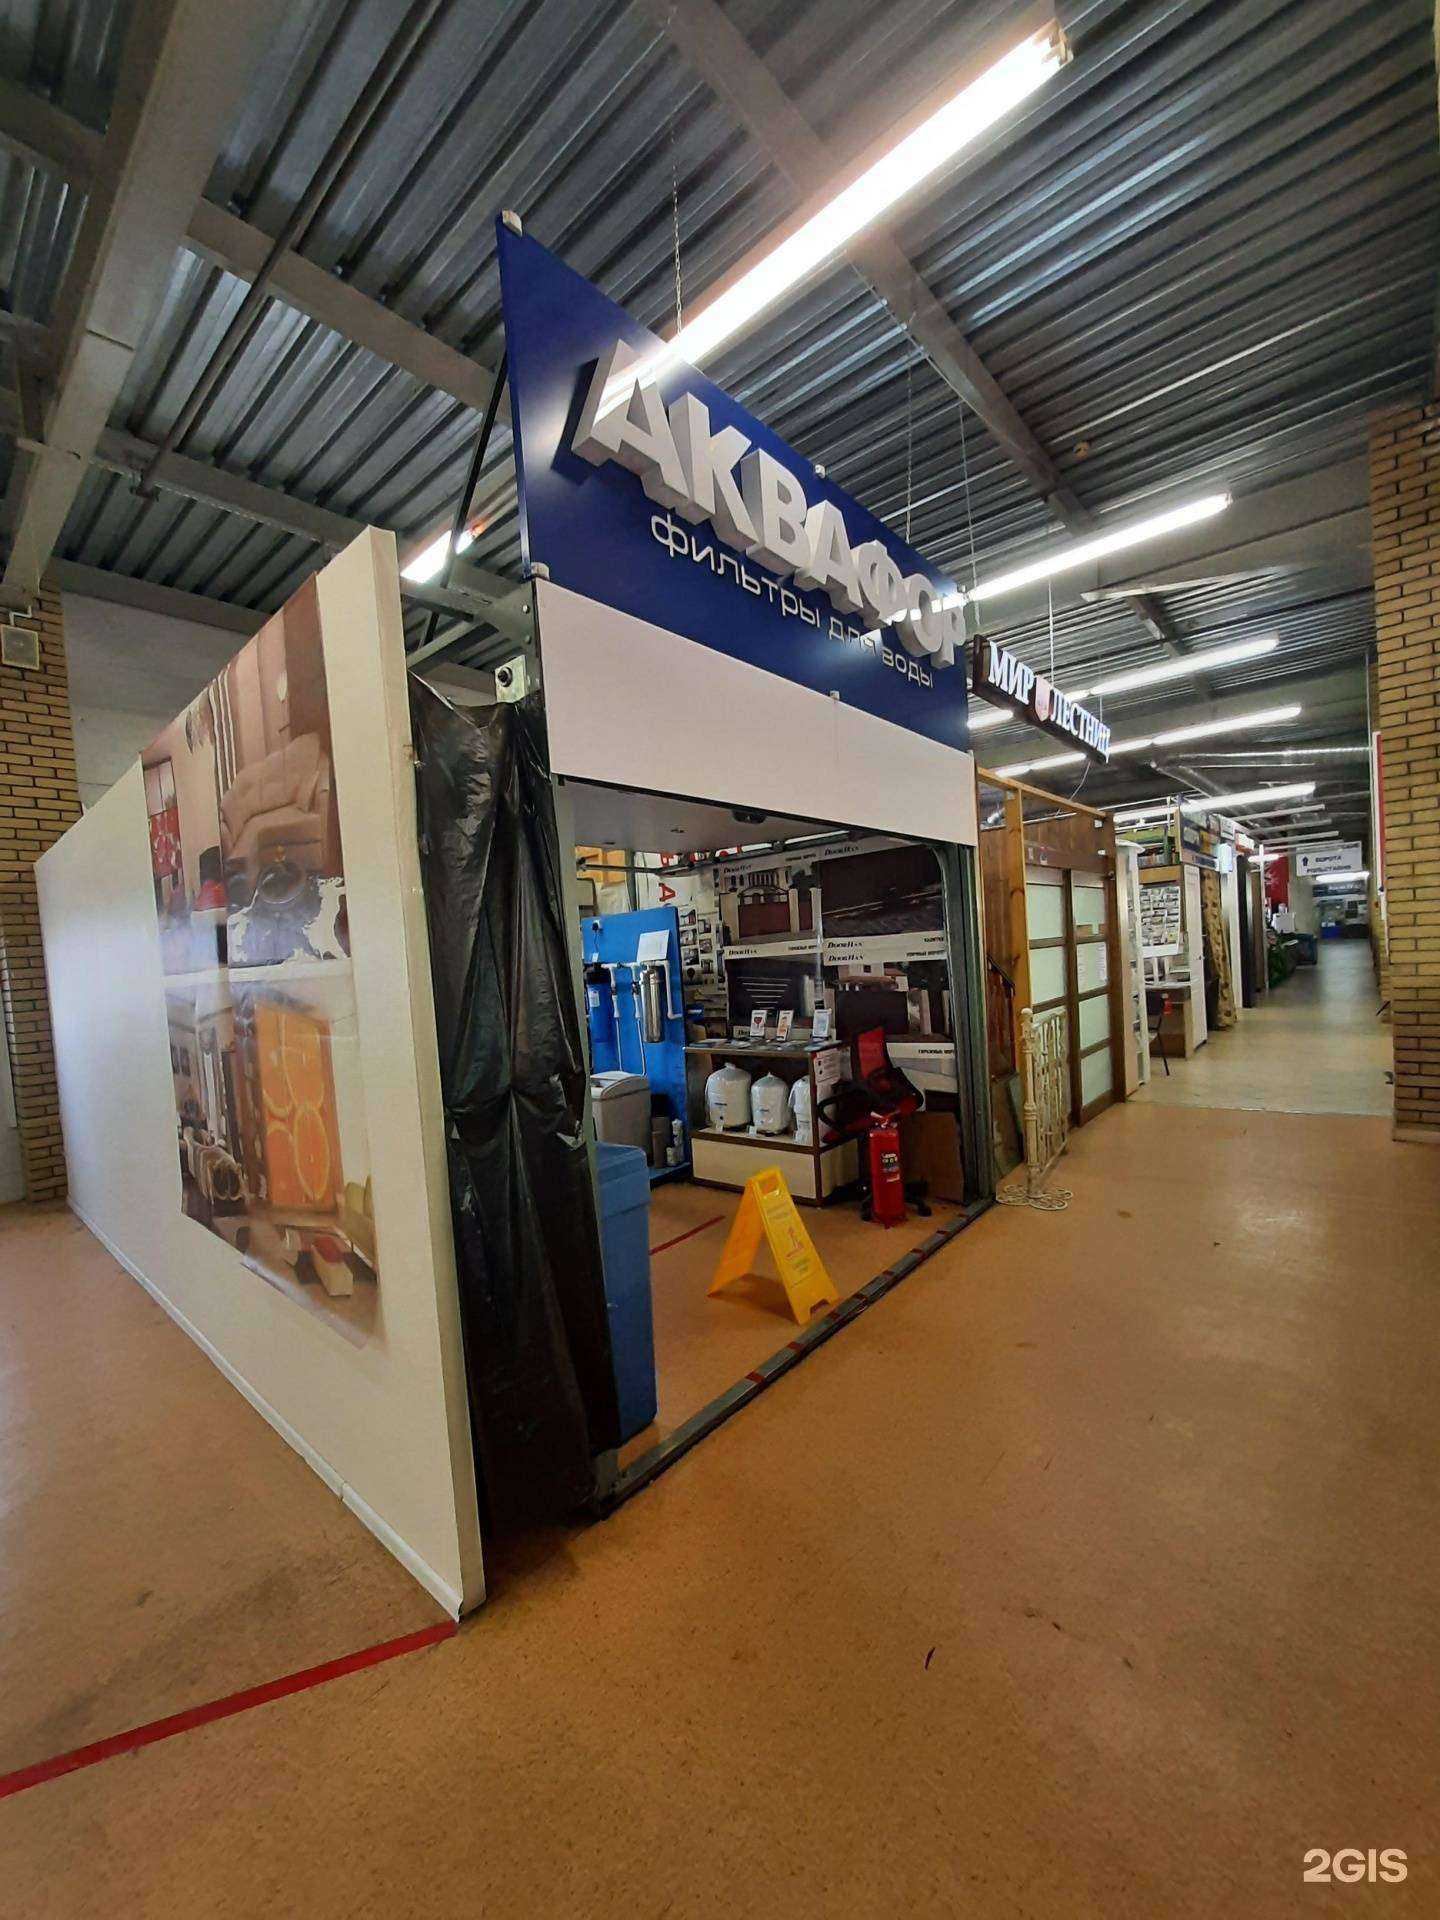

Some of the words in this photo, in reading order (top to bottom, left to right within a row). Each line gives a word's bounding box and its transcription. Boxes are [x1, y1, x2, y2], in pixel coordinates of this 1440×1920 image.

[571, 338, 966, 669] АКВАФОР
[651, 514, 820, 628] фильтры
[829, 616, 876, 656] для
[882, 645, 934, 688] воды
[988, 640, 1036, 705] МИР
[1049, 687, 1110, 764] ЛЕСТНИЦ
